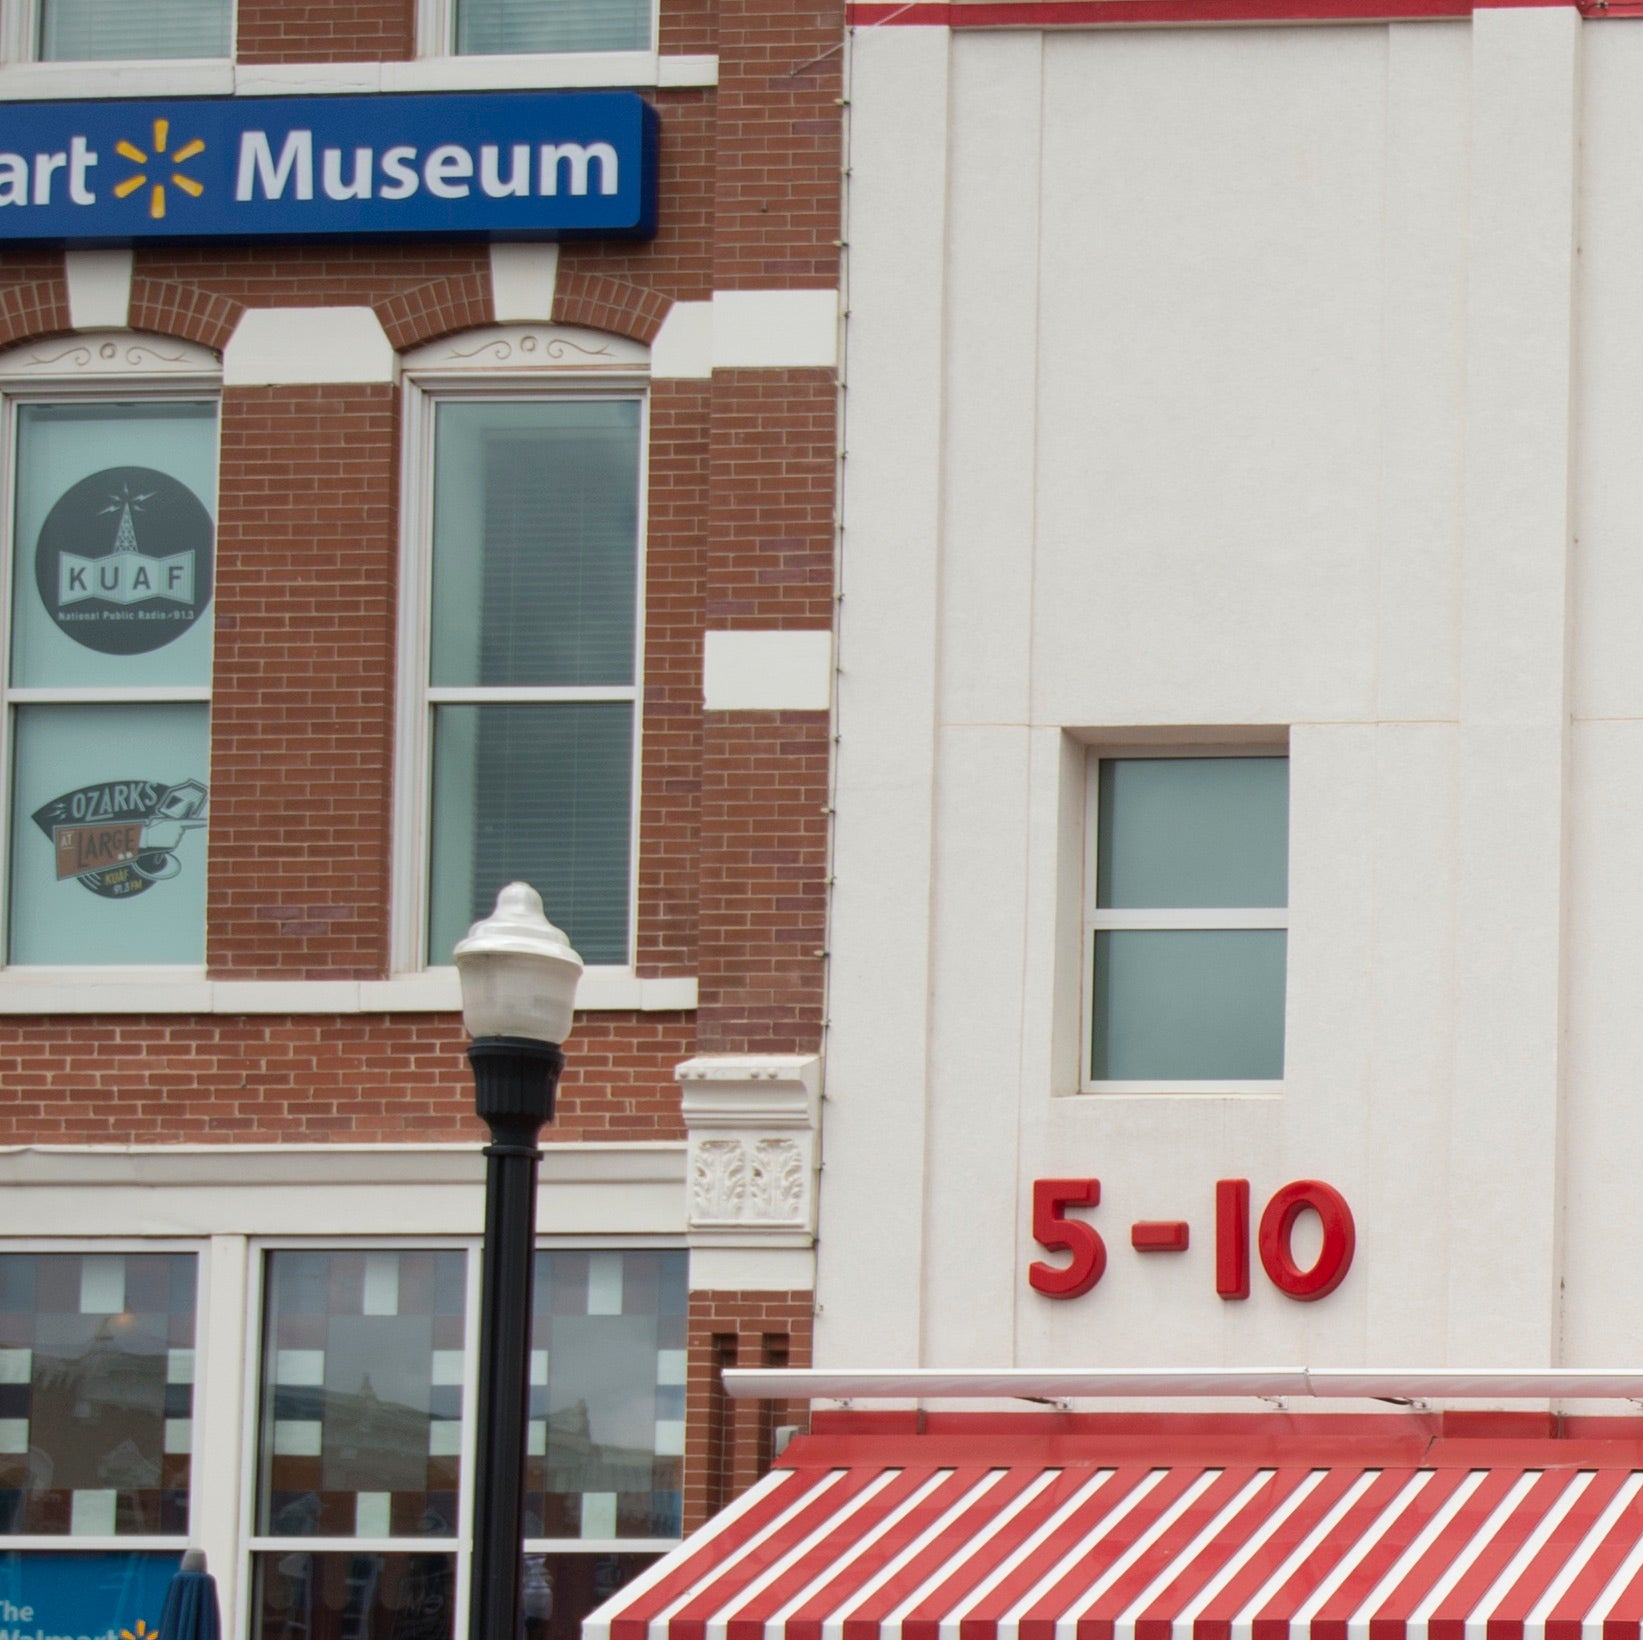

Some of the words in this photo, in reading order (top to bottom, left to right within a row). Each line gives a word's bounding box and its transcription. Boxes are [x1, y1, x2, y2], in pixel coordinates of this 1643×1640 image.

[236, 129, 619, 201] Museum
[69, 566, 184, 591] KUAF
[58, 610, 99, 621] National
[103, 610, 134, 620] Public
[138, 610, 166, 620] Radio
[71, 782, 158, 821] OZARKS
[60, 832, 73, 848] AT
[76, 827, 135, 867] LARGE
[1029, 1178, 1356, 1301] 5-10
